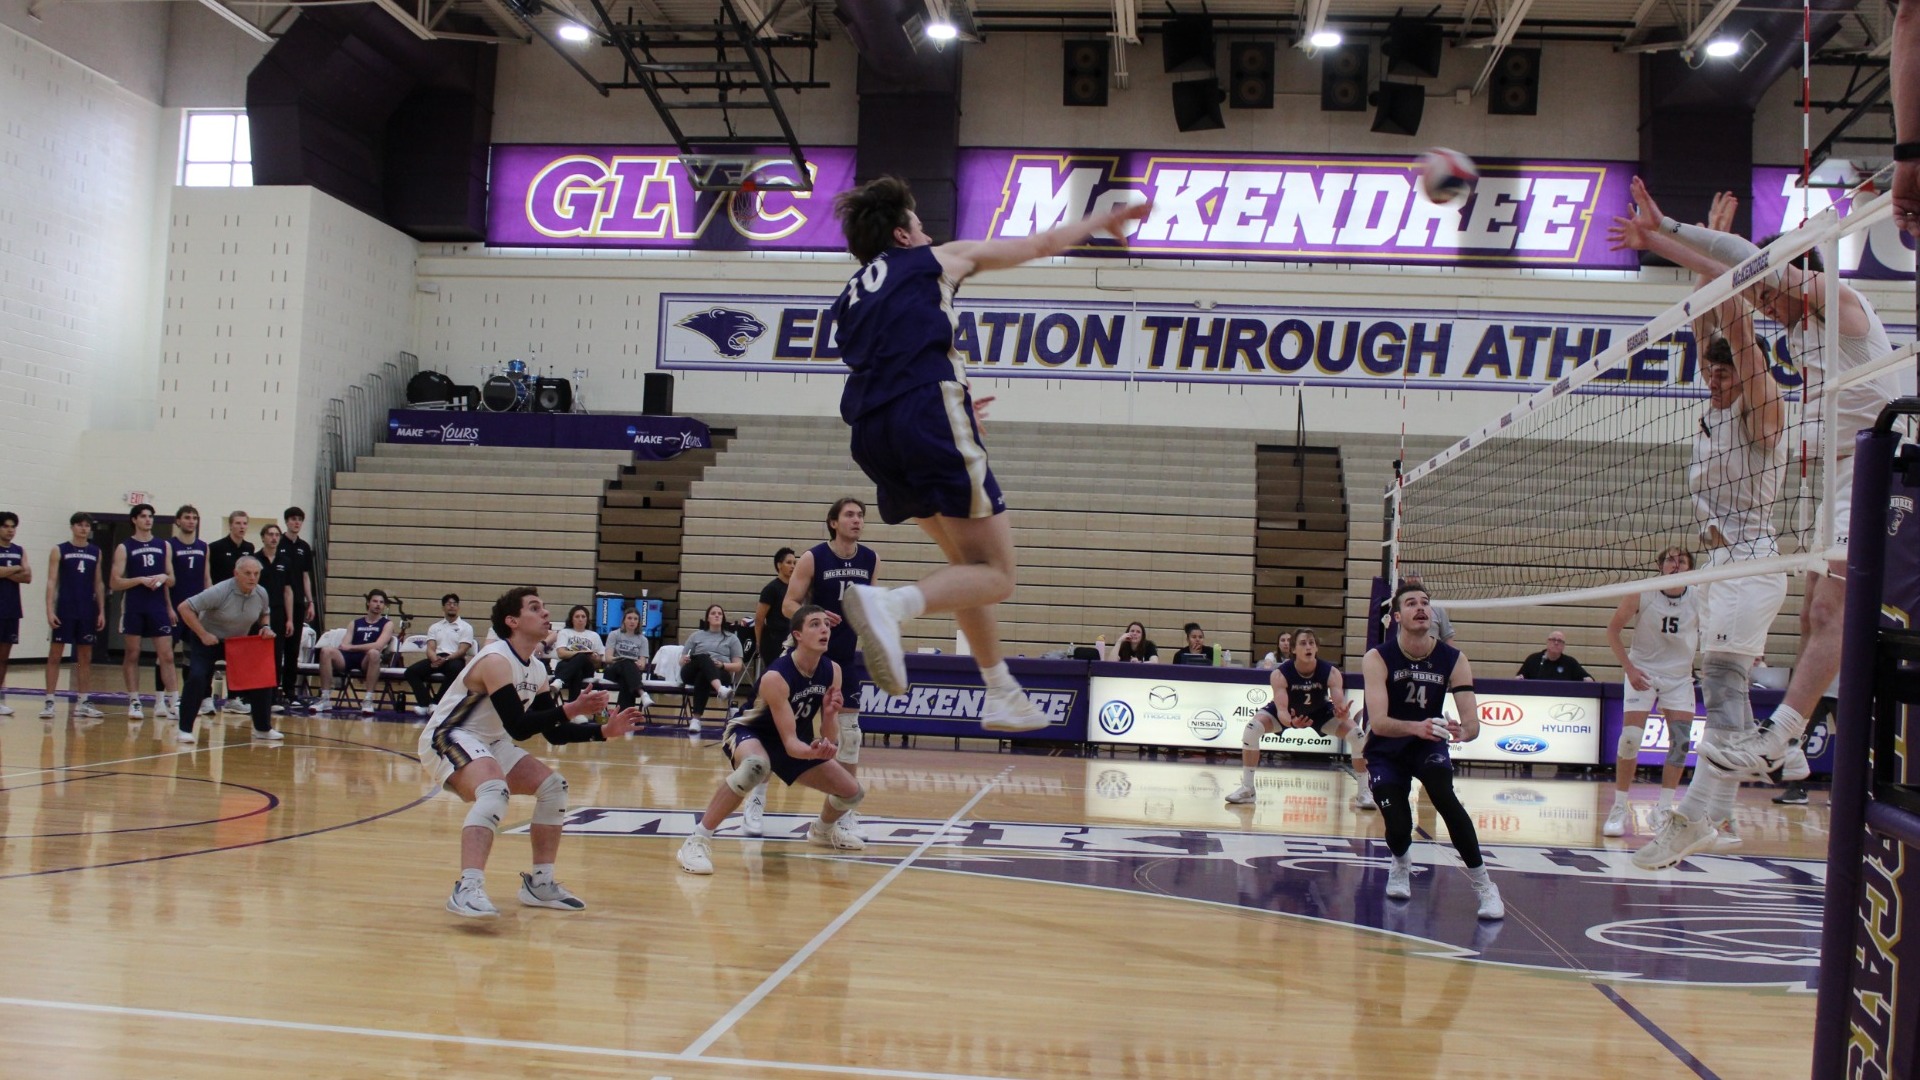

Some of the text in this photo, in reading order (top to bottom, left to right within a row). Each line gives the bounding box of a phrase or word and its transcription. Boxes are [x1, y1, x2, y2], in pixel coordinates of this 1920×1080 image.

[525, 155, 817, 240] GLVC
[1000, 165, 1592, 251] McKENDREE
[848, 259, 888, 309] 10
[1142, 316, 1461, 376] THROUGH
[396, 422, 479, 443] MAKE YOURS
[634, 435, 663, 444] MAKE
[77, 560, 86, 573] 4
[142, 554, 155, 567] 18
[188, 556, 195, 569] 7
[824, 568, 869, 580] McKENDREE
[1661, 616, 1679, 634] 15
[1304, 694, 1312, 705] 2
[1405, 682, 1427, 709] 24
[859, 685, 1072, 722] McKENEE
[1482, 706, 1514, 720] KIA
[1191, 719, 1223, 728] NISSAN
[1542, 725, 1591, 733] HYUNDAI
[1505, 737, 1538, 752] Ford
